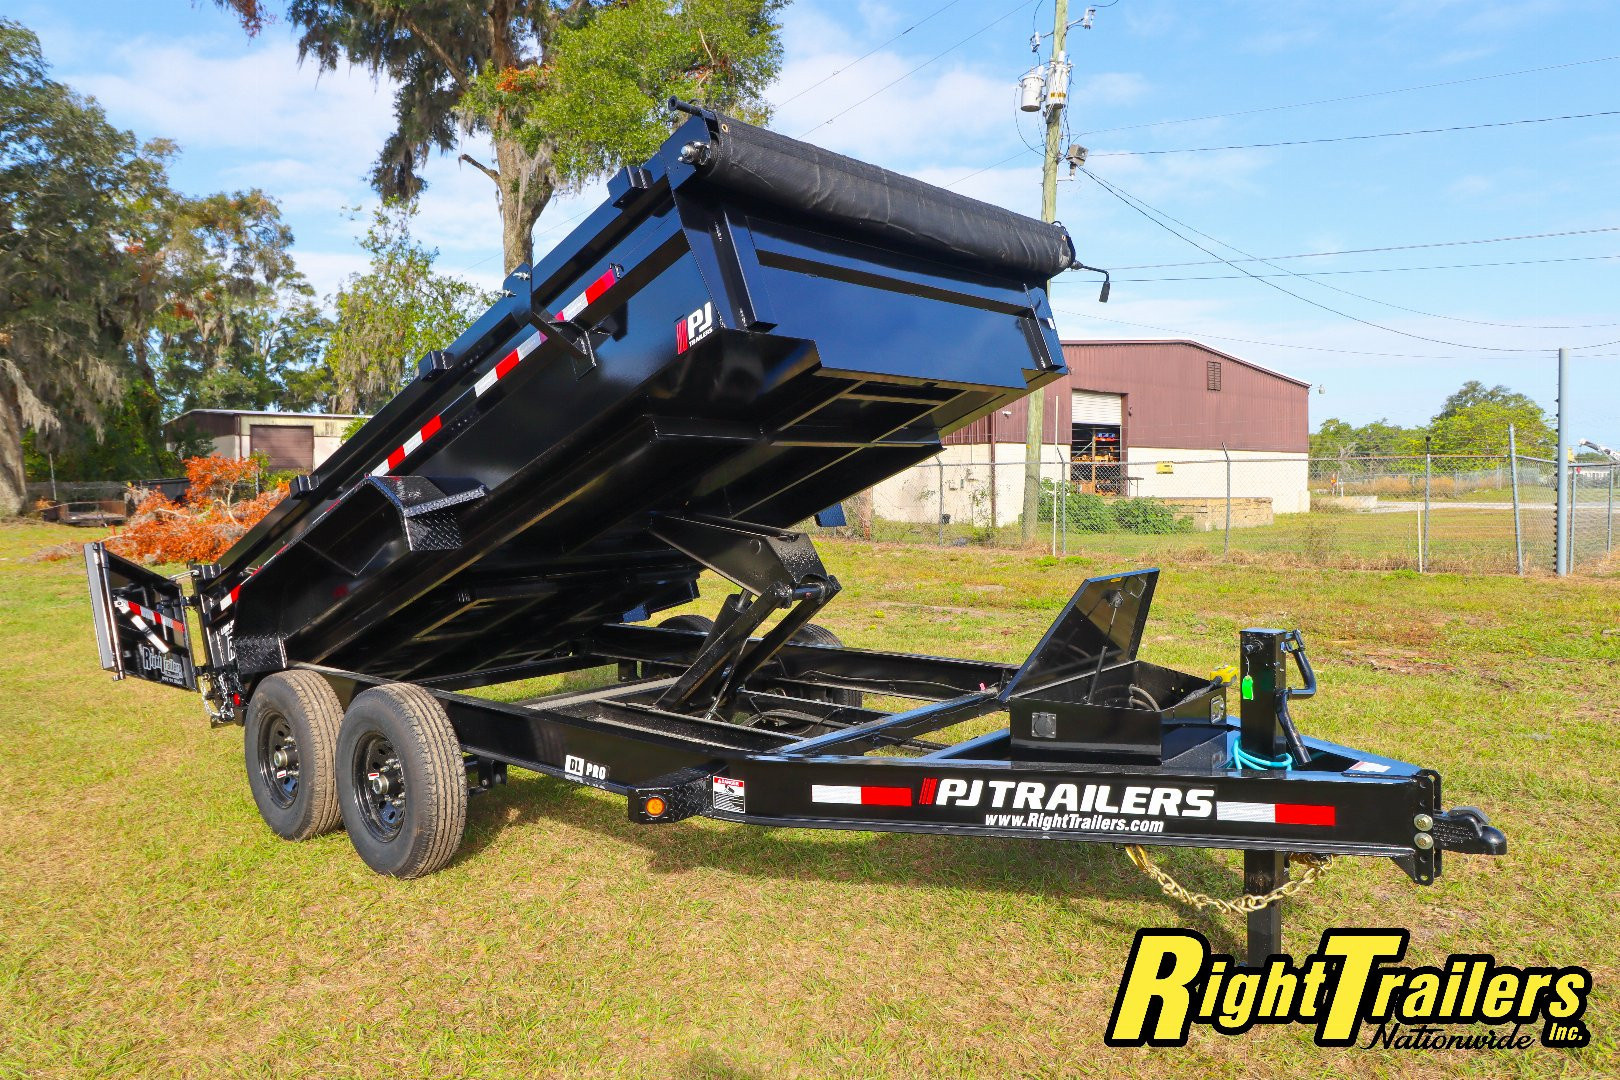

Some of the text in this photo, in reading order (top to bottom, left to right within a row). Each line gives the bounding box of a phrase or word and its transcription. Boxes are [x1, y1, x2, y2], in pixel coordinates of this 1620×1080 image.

[687, 301, 712, 341] PJ
[689, 326, 713, 347] TRAILERS
[585, 762, 606, 780] PRO
[936, 778, 1215, 818] PJ TRAILERS
[985, 812, 1164, 833] www.RightTrailers.com
